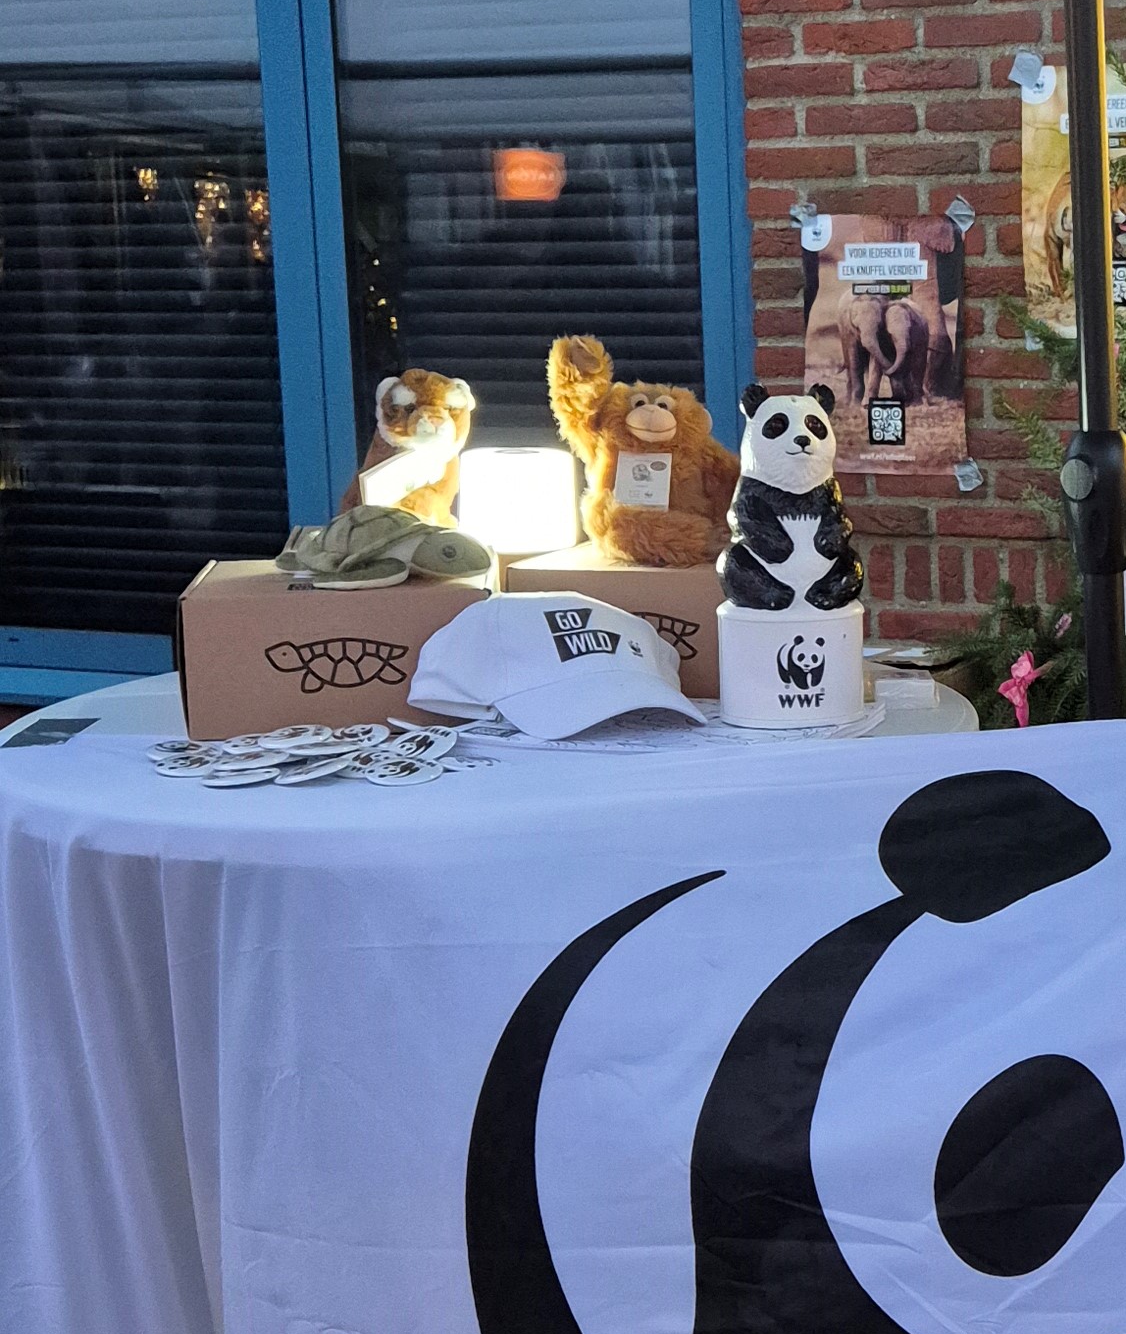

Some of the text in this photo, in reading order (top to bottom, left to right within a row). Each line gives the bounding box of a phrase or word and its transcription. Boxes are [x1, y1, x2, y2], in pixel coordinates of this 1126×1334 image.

[848, 247, 916, 259] VOOR IEDEREEN DIE
[842, 264, 923, 276] EEN KNUFFEL VERDIENT
[555, 611, 583, 630] GO
[563, 631, 612, 655] WILD
[778, 693, 825, 709] WWF
